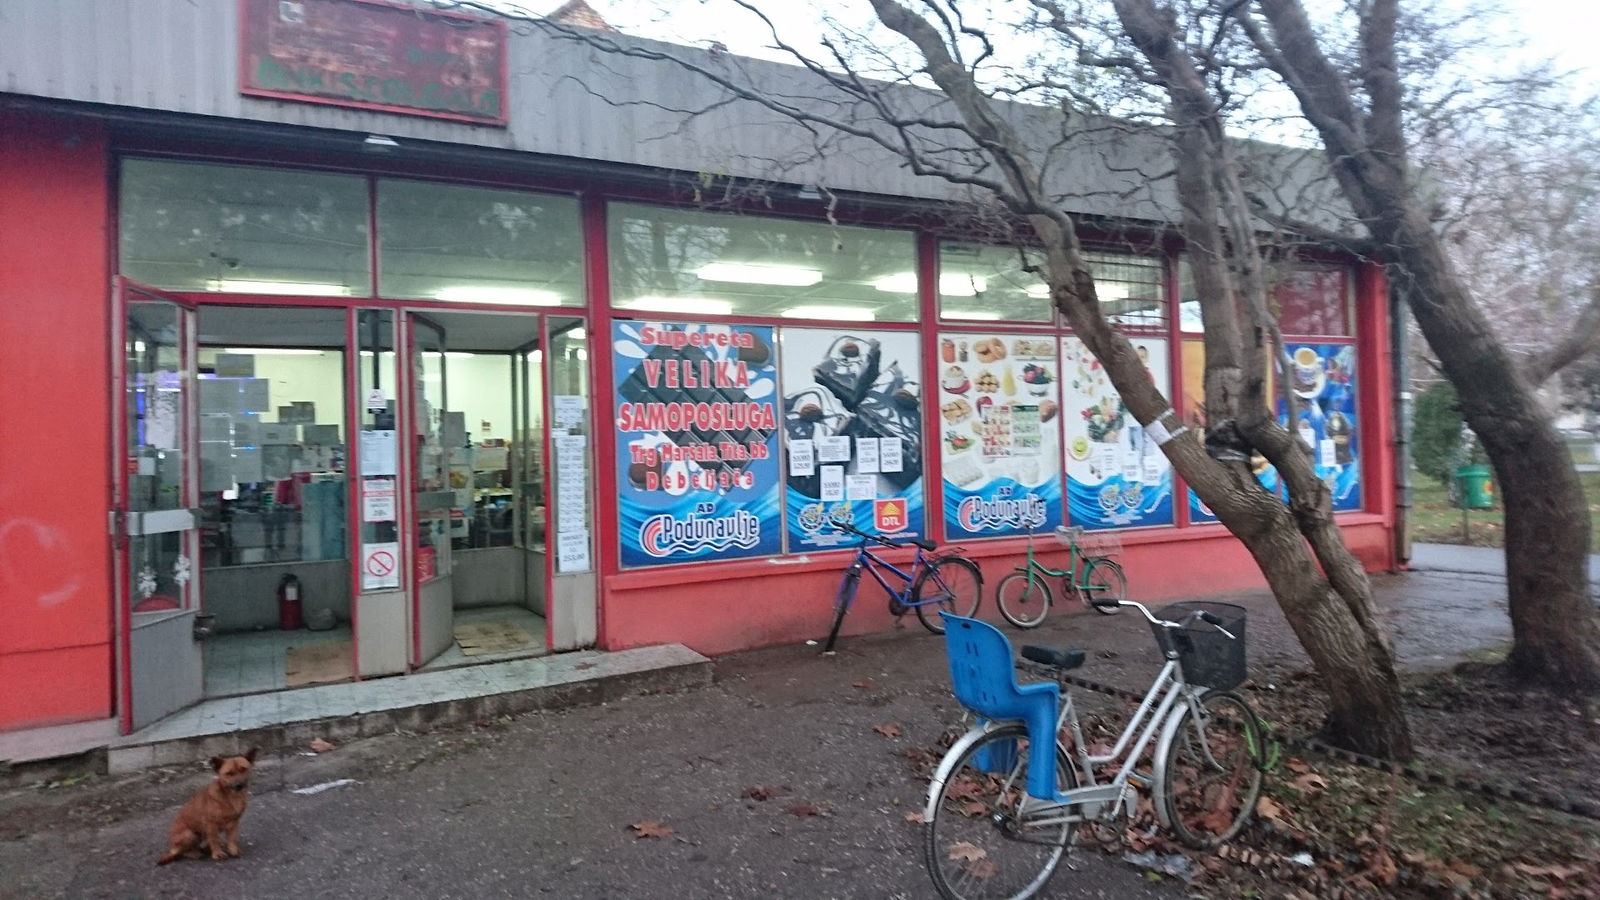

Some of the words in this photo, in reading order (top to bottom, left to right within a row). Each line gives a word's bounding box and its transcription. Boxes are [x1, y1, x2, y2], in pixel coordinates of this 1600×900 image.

[639, 327, 754, 350] Supereta
[643, 359, 751, 389] VELIKA
[619, 403, 776, 431] SAMOPOSLUGA
[630, 444, 657, 467] Trg
[719, 441, 748, 460] Tita
[749, 440, 769, 459] bb
[661, 510, 759, 543] Podunavlje
[881, 516, 902, 527] DTL
